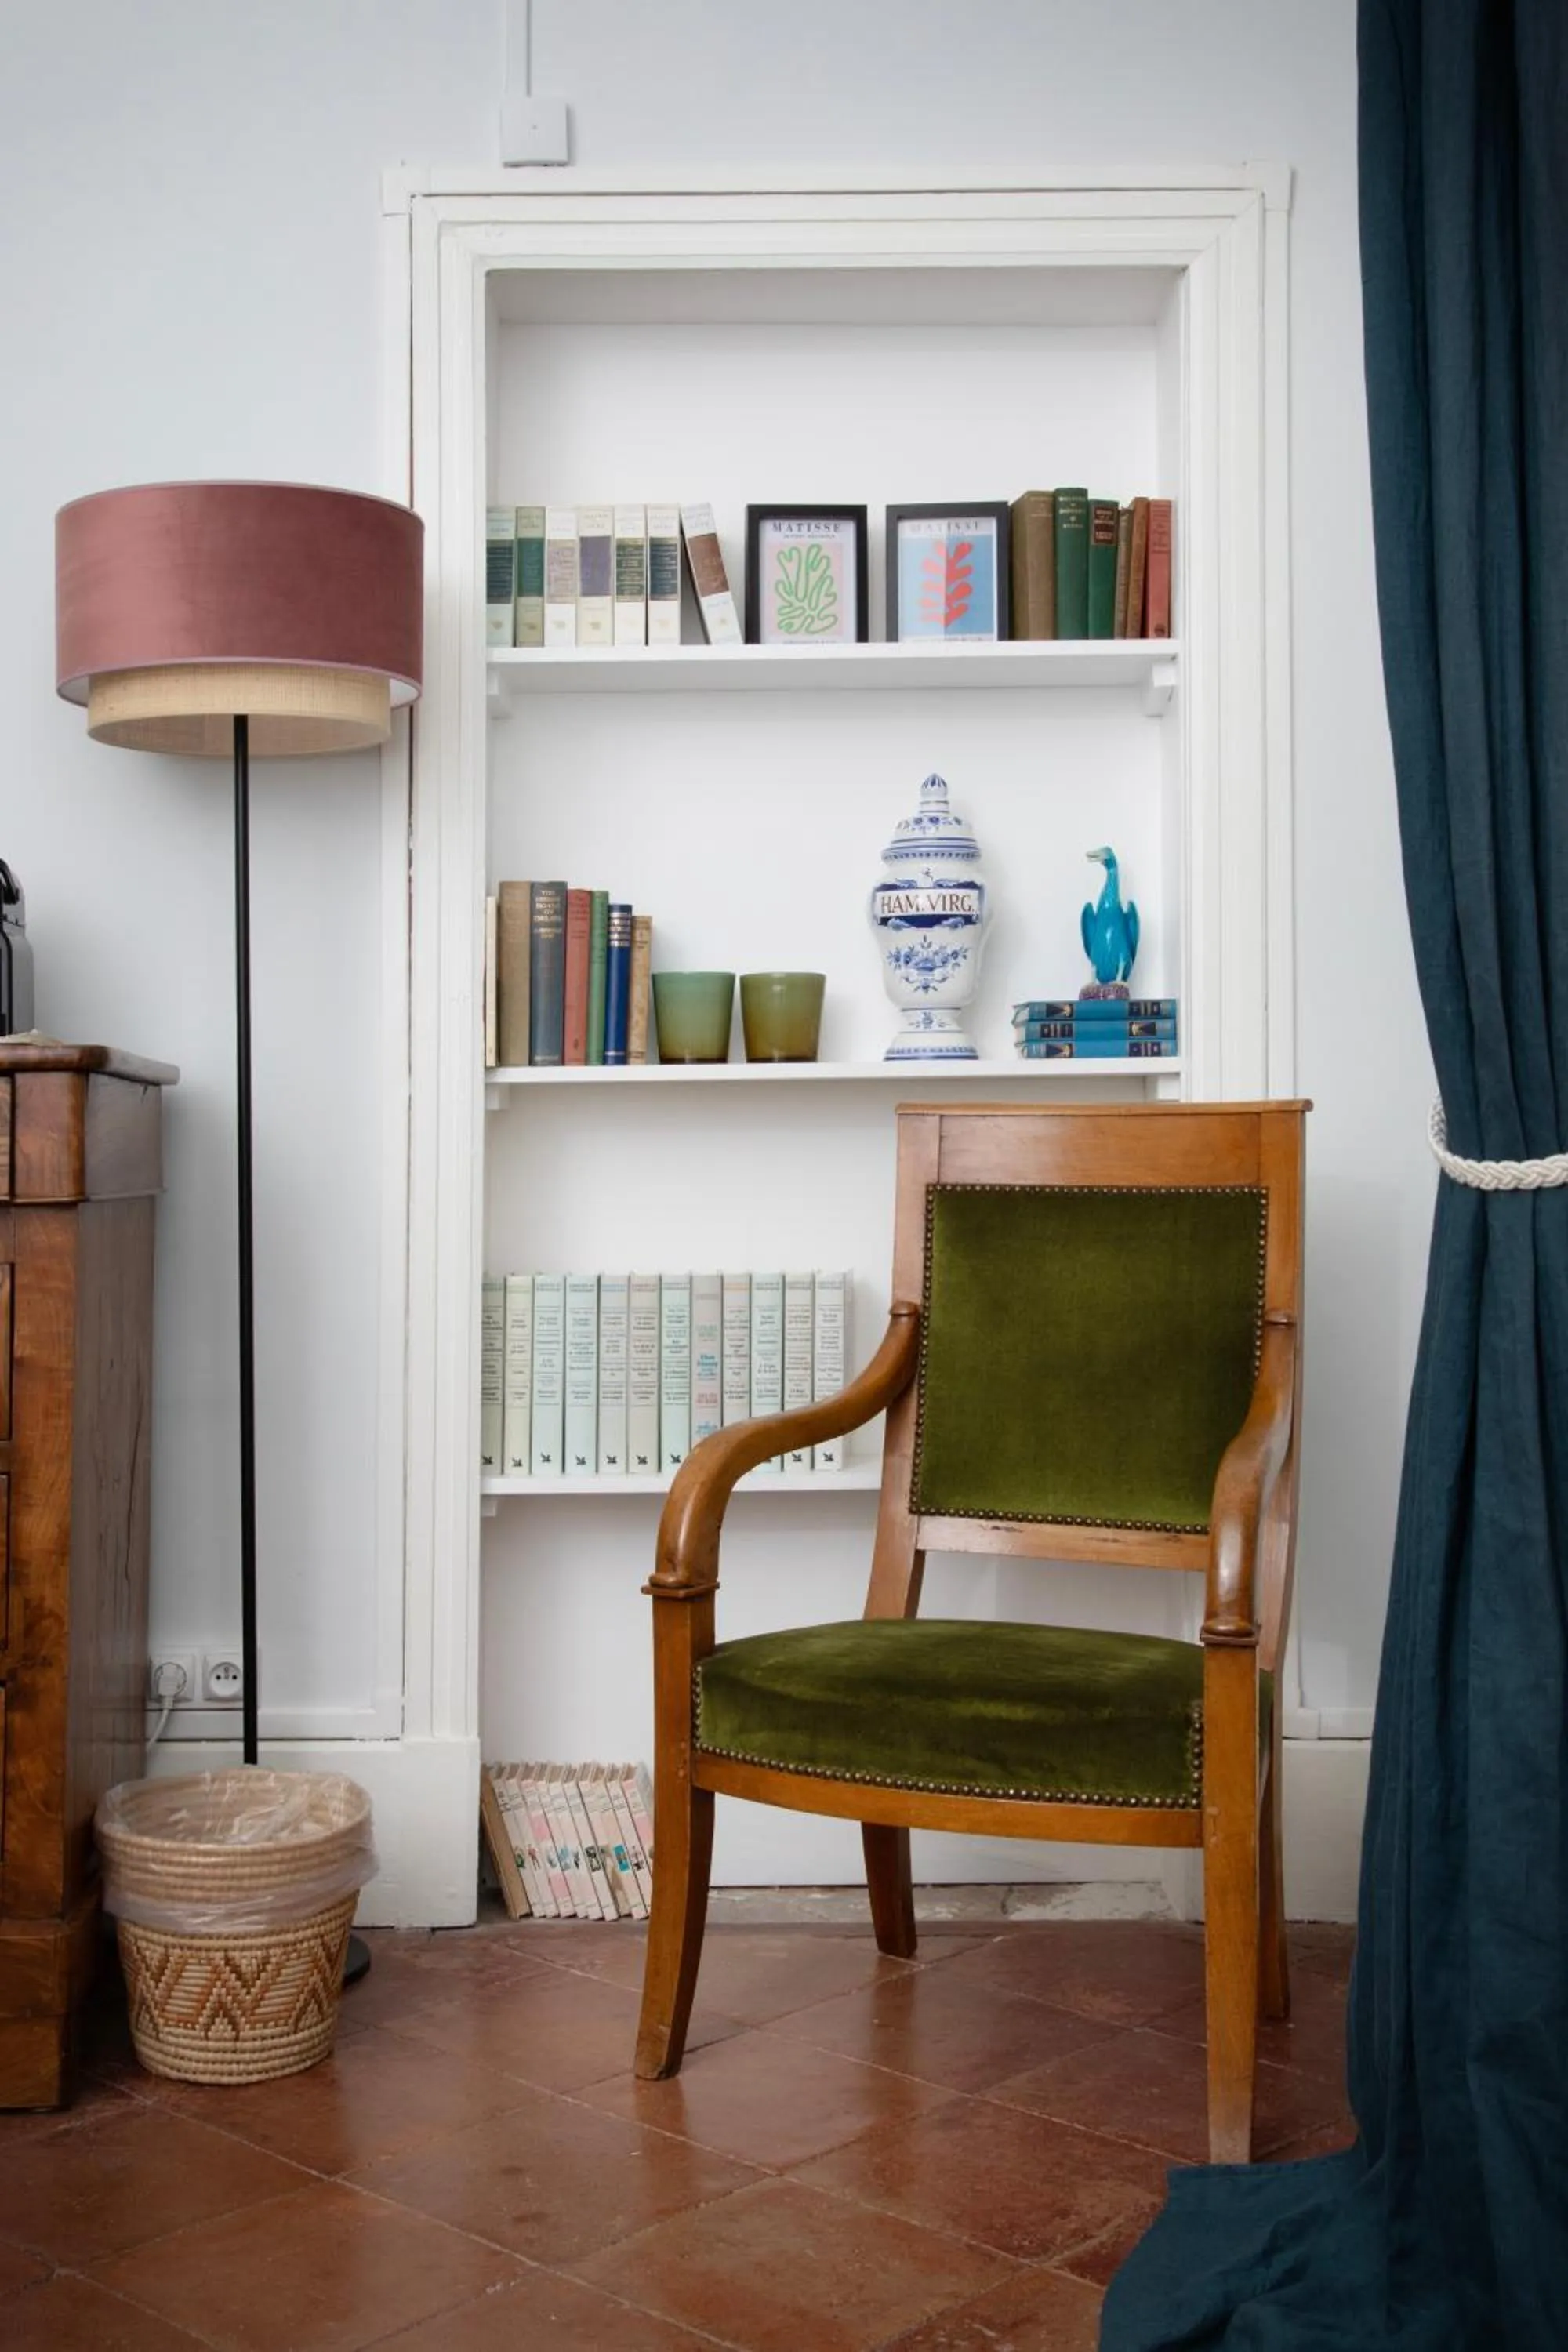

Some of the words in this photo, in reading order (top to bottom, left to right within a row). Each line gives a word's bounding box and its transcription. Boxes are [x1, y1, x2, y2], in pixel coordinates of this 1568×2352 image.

[772, 521, 841, 532] MATISSE
[880, 894, 925, 914] HAM.
[926, 893, 975, 913] VIRG.
